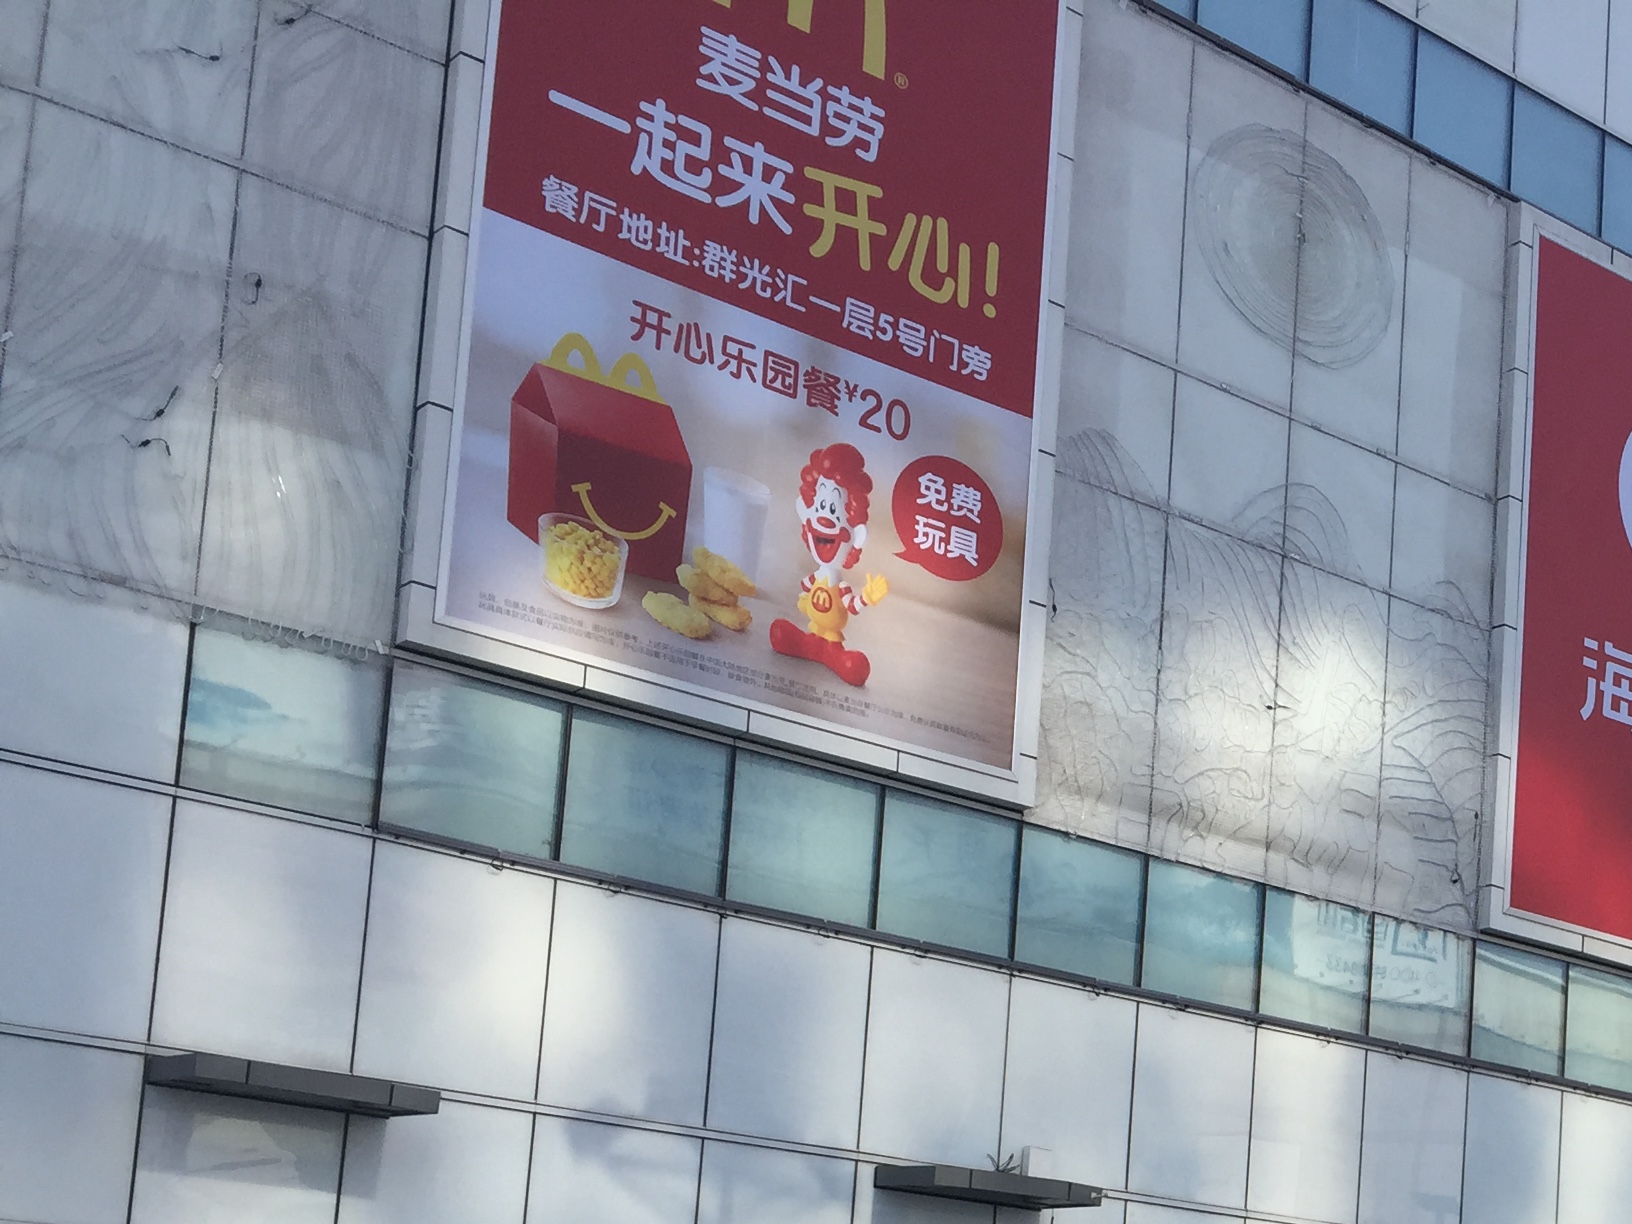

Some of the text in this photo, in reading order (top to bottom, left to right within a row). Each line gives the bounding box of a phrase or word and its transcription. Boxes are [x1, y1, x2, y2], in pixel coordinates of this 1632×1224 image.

[695, 24, 886, 163] 麦当劳
[915, 471, 982, 525] 免费
[912, 514, 979, 568] 玩具
